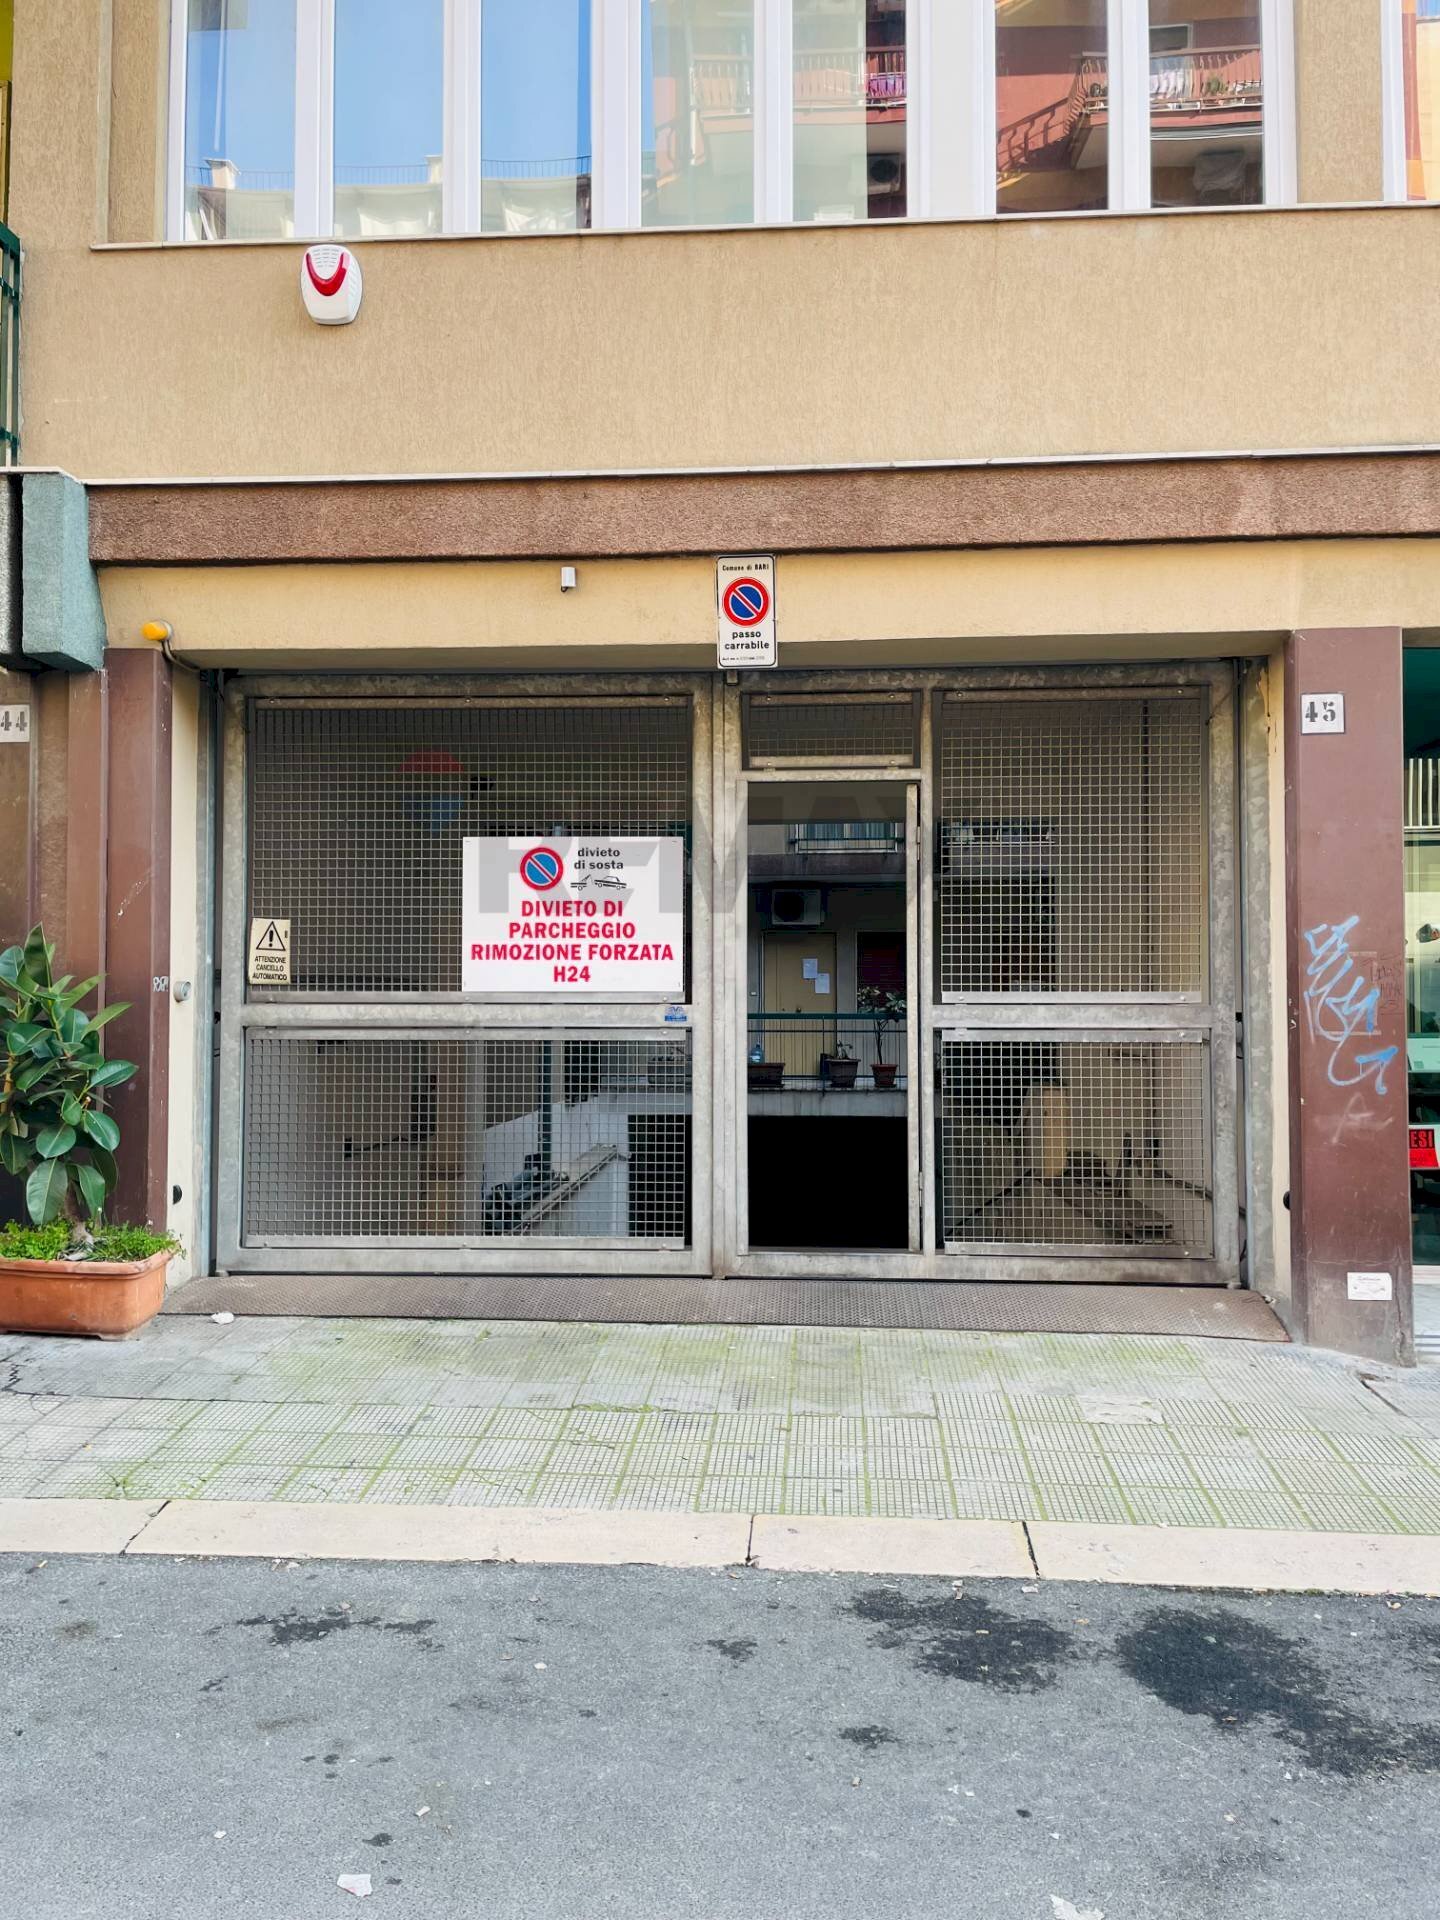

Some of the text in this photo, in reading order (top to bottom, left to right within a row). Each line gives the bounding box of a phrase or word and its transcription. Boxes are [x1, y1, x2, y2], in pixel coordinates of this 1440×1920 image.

[732, 631, 761, 640] passo
[724, 641, 770, 650] carrabile
[1305, 701, 1336, 722] 45
[0, 710, 28, 732] 44
[577, 847, 621, 857] divieto
[574, 860, 624, 870] di sosta
[521, 900, 623, 917] DIVIETO DI
[509, 922, 636, 939] PARCHEGGIO
[471, 944, 674, 961] RIMOZIONE FORZATA
[254, 956, 287, 964] ATTENZIONE
[256, 964, 284, 972] CANCELLO
[553, 966, 591, 982] H24
[252, 973, 288, 981] AUTOMATICO
[1410, 1130, 1433, 1148] ESI
